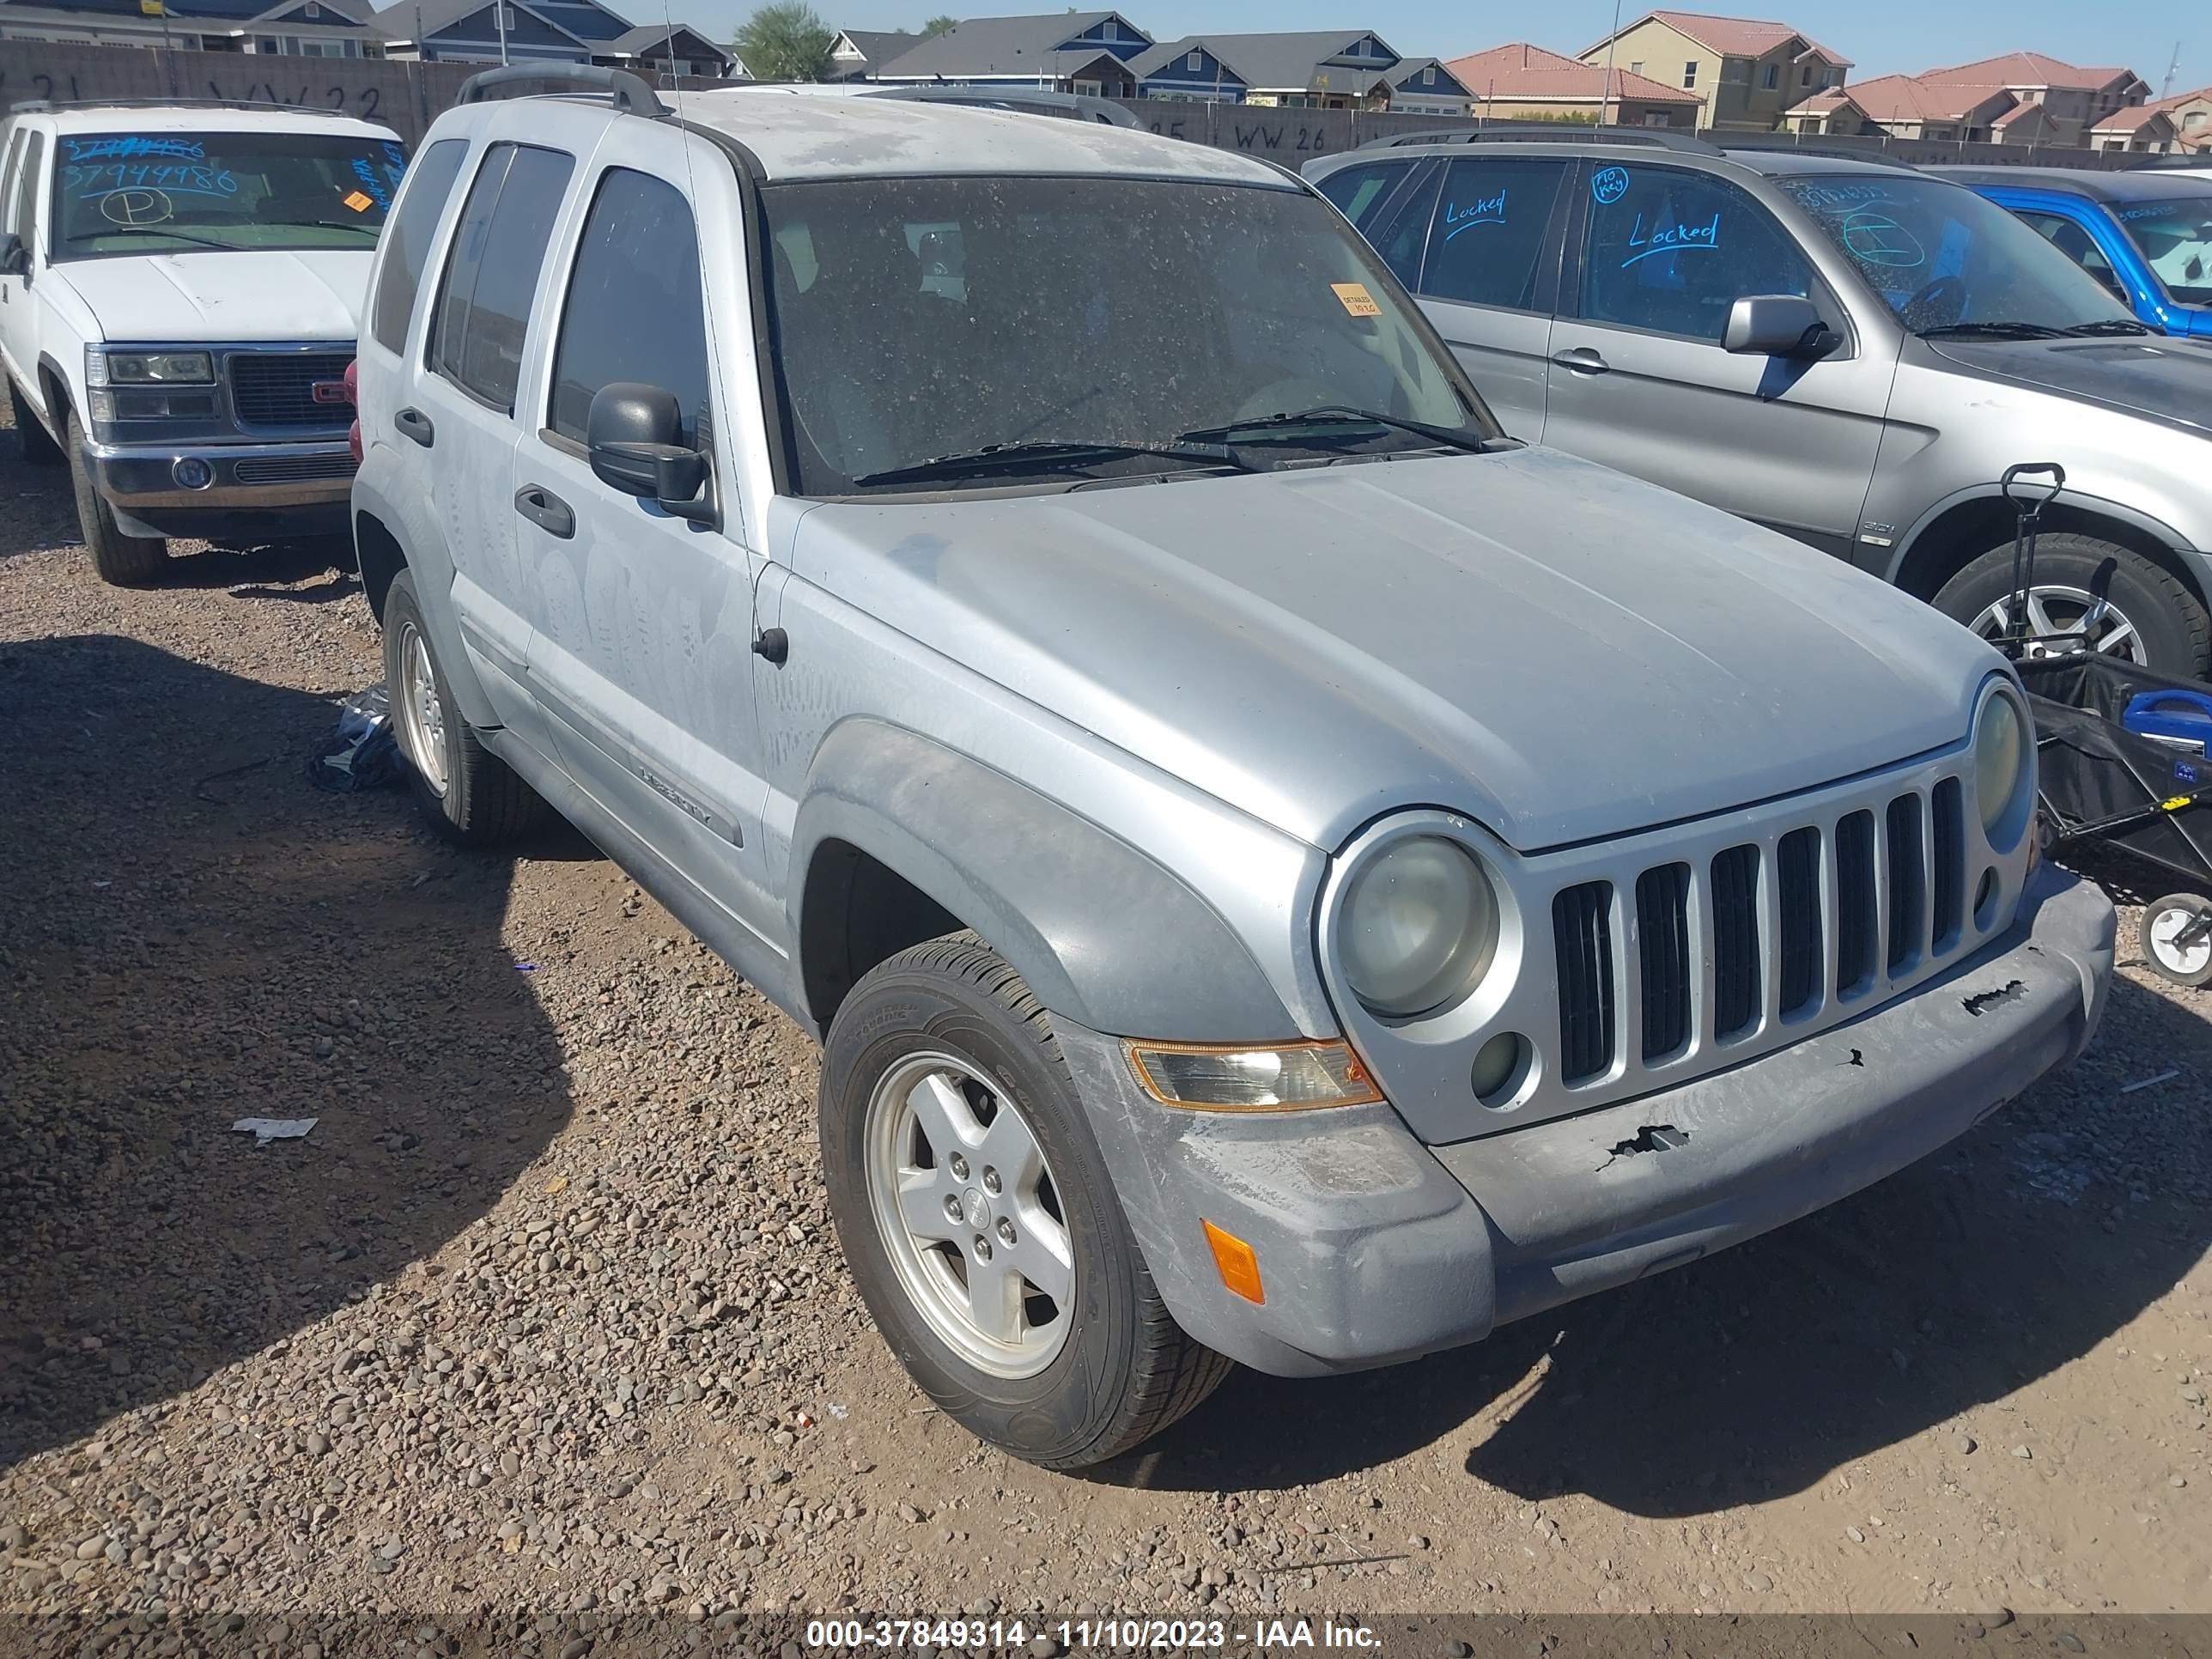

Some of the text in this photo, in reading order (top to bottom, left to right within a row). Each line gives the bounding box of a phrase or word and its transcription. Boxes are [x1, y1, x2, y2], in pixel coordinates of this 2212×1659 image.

[1235, 125, 1325, 151] WW 26
[60, 163, 238, 193] 37944986
[109, 191, 155, 225] P
[1446, 189, 1506, 223] Locked
[1629, 213, 1718, 246] Locked
